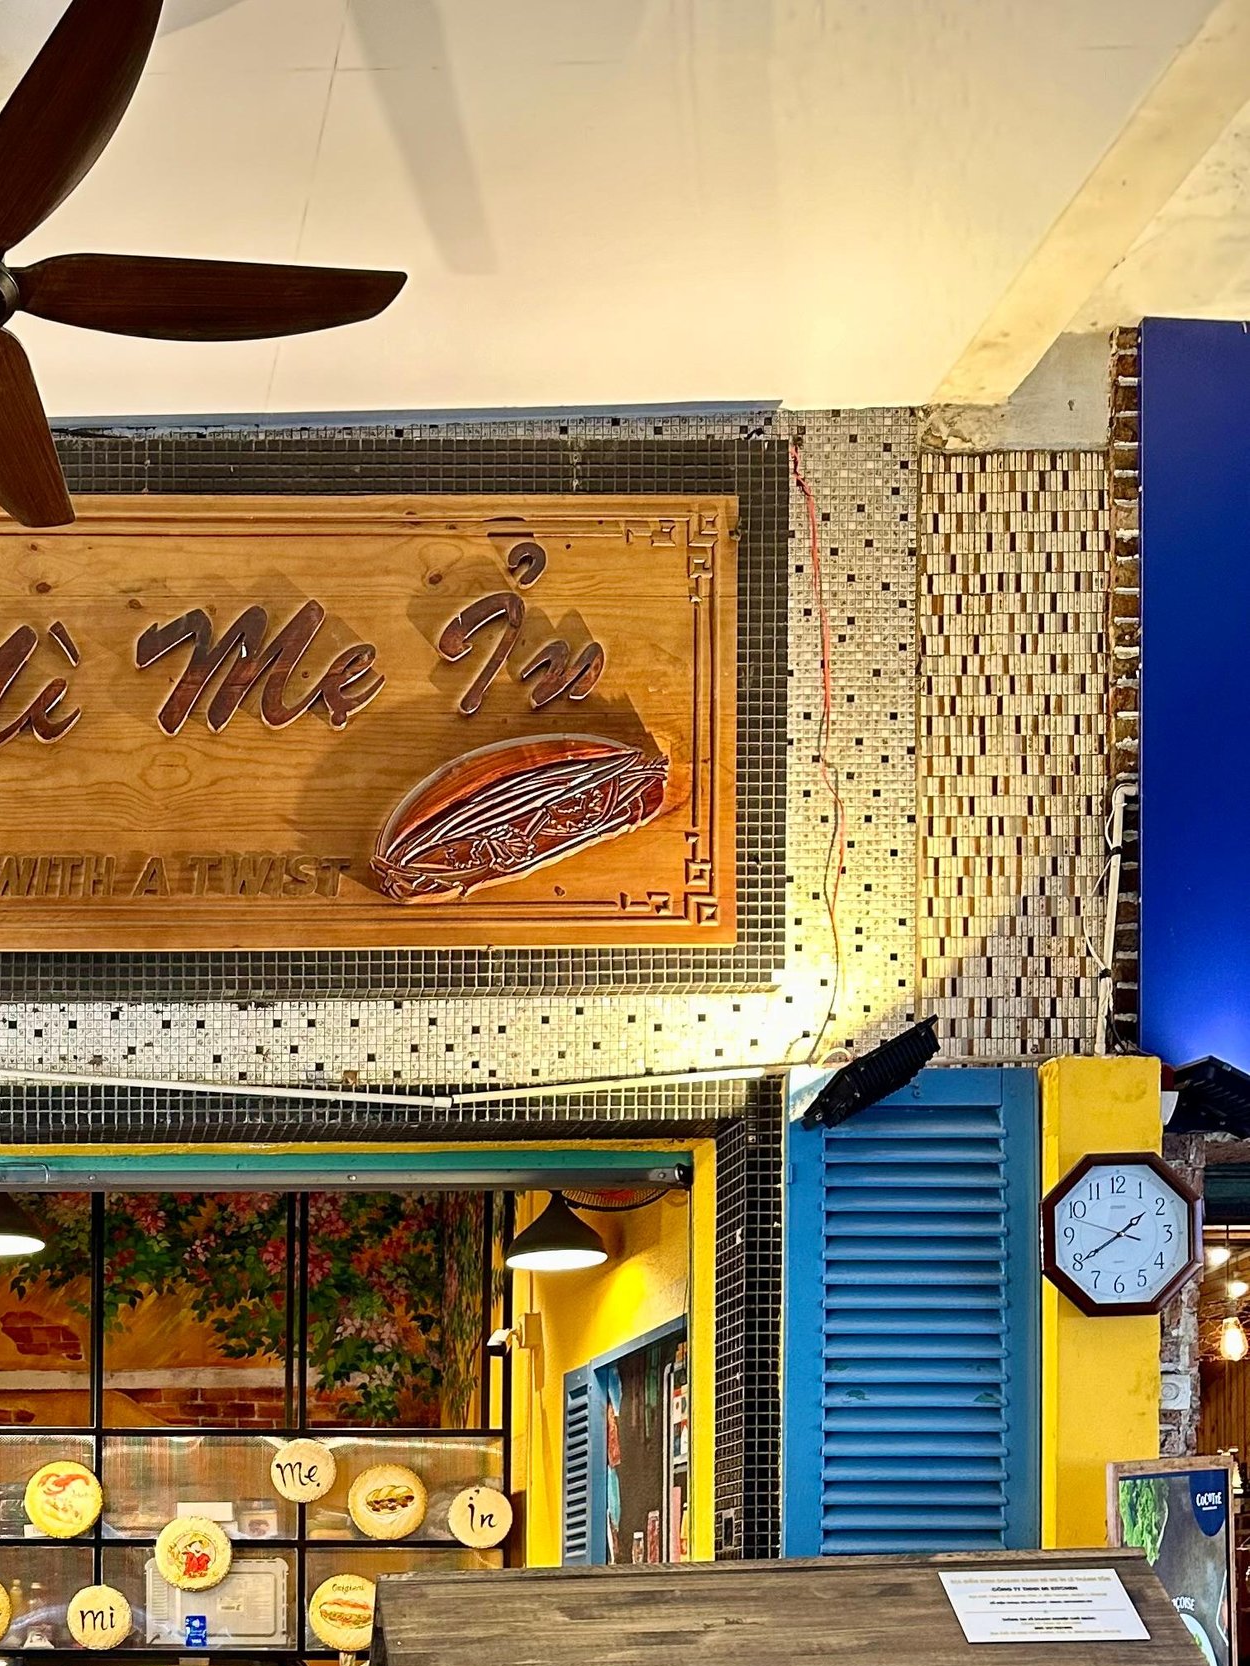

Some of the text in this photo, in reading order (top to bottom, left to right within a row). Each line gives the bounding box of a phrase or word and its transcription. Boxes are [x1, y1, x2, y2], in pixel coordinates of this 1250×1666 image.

[135, 599, 386, 737] Mẹ
[132, 855, 170, 897] A
[188, 855, 350, 897] TWIST
[1089, 1182, 1100, 1200] 11
[1111, 1175, 1126, 1194] 12
[1138, 1181, 1143, 1199] 1
[1069, 1200, 1087, 1219] 10
[1155, 1198, 1165, 1216] 2
[1064, 1227, 1075, 1246] 9
[1163, 1225, 1173, 1243] 3
[1072, 1252, 1084, 1271] 8
[1154, 1251, 1165, 1269] 4
[1091, 1271, 1101, 1289] 7
[1114, 1275, 1125, 1293] 6
[1137, 1269, 1148, 1287] 5
